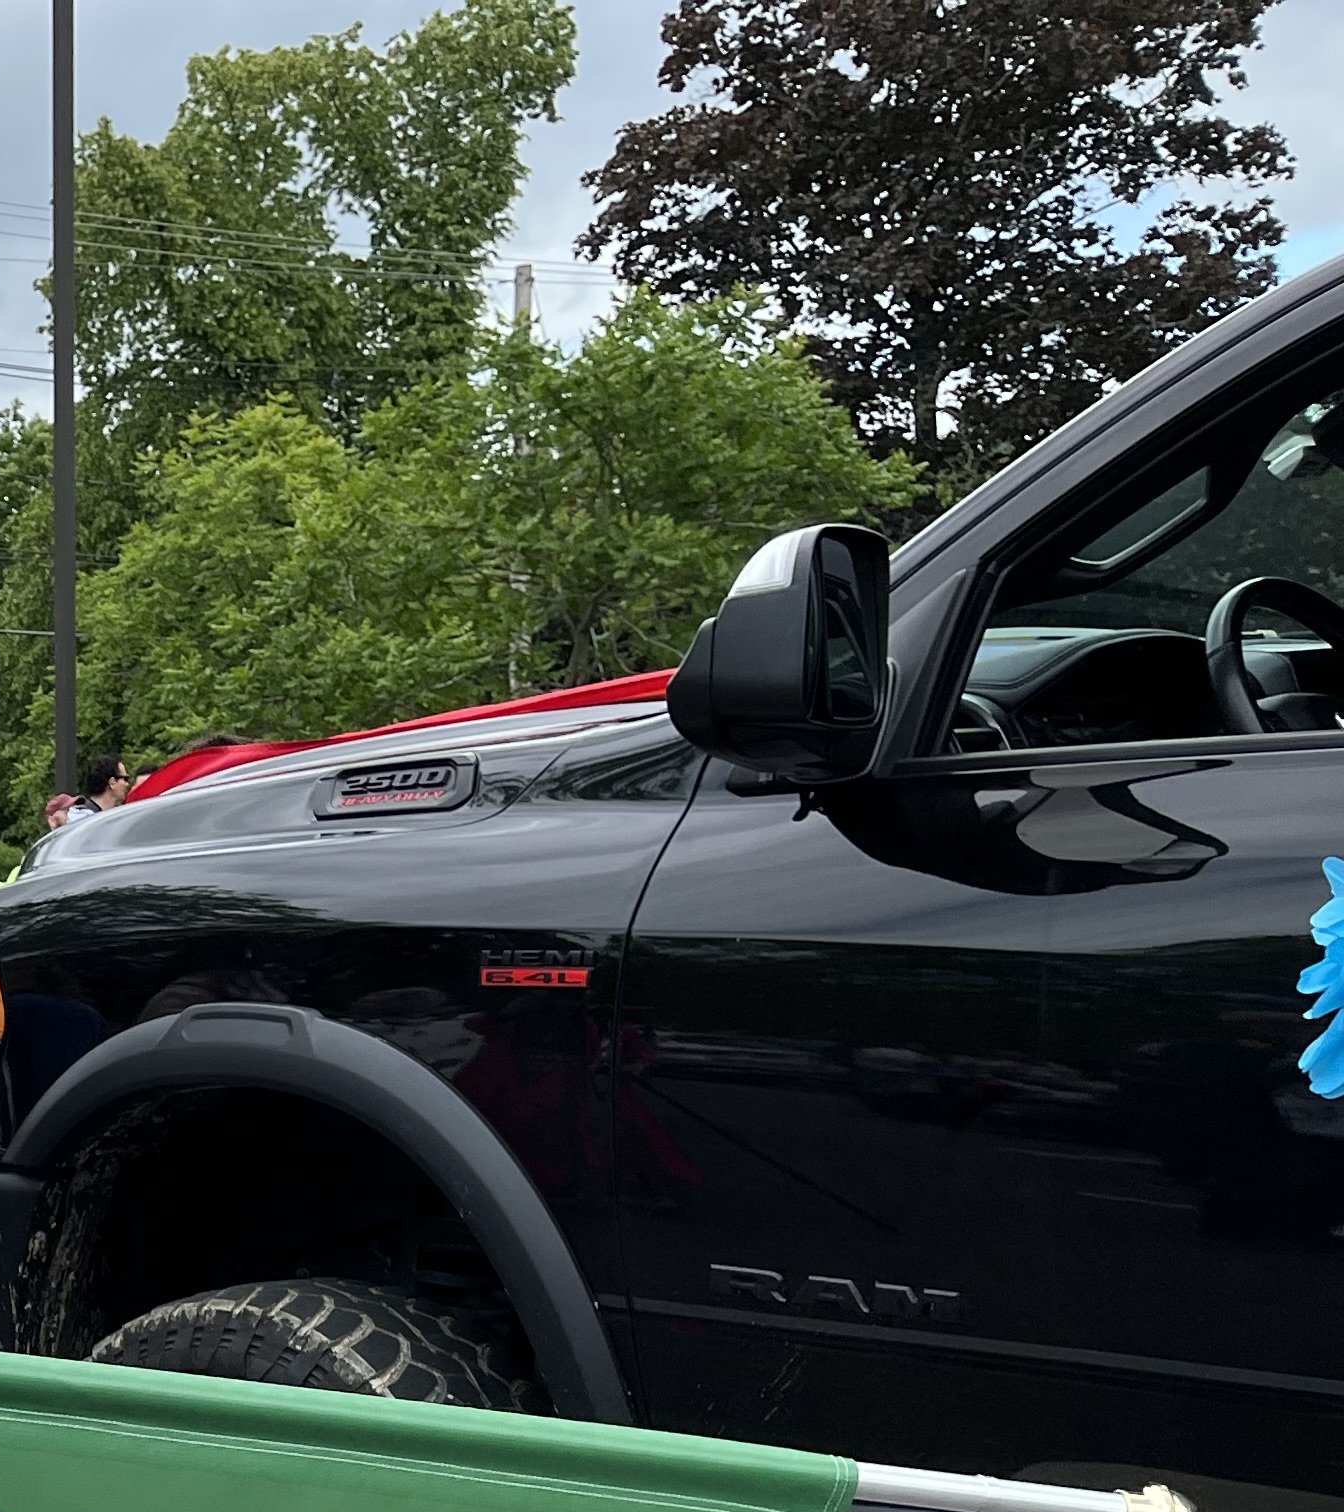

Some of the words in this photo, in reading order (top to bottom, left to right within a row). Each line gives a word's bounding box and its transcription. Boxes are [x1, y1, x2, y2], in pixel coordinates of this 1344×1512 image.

[340, 768, 451, 797] 2500
[481, 949, 594, 966] HEMI
[485, 971, 584, 984] 6.4L
[710, 1263, 962, 1324] RAM
